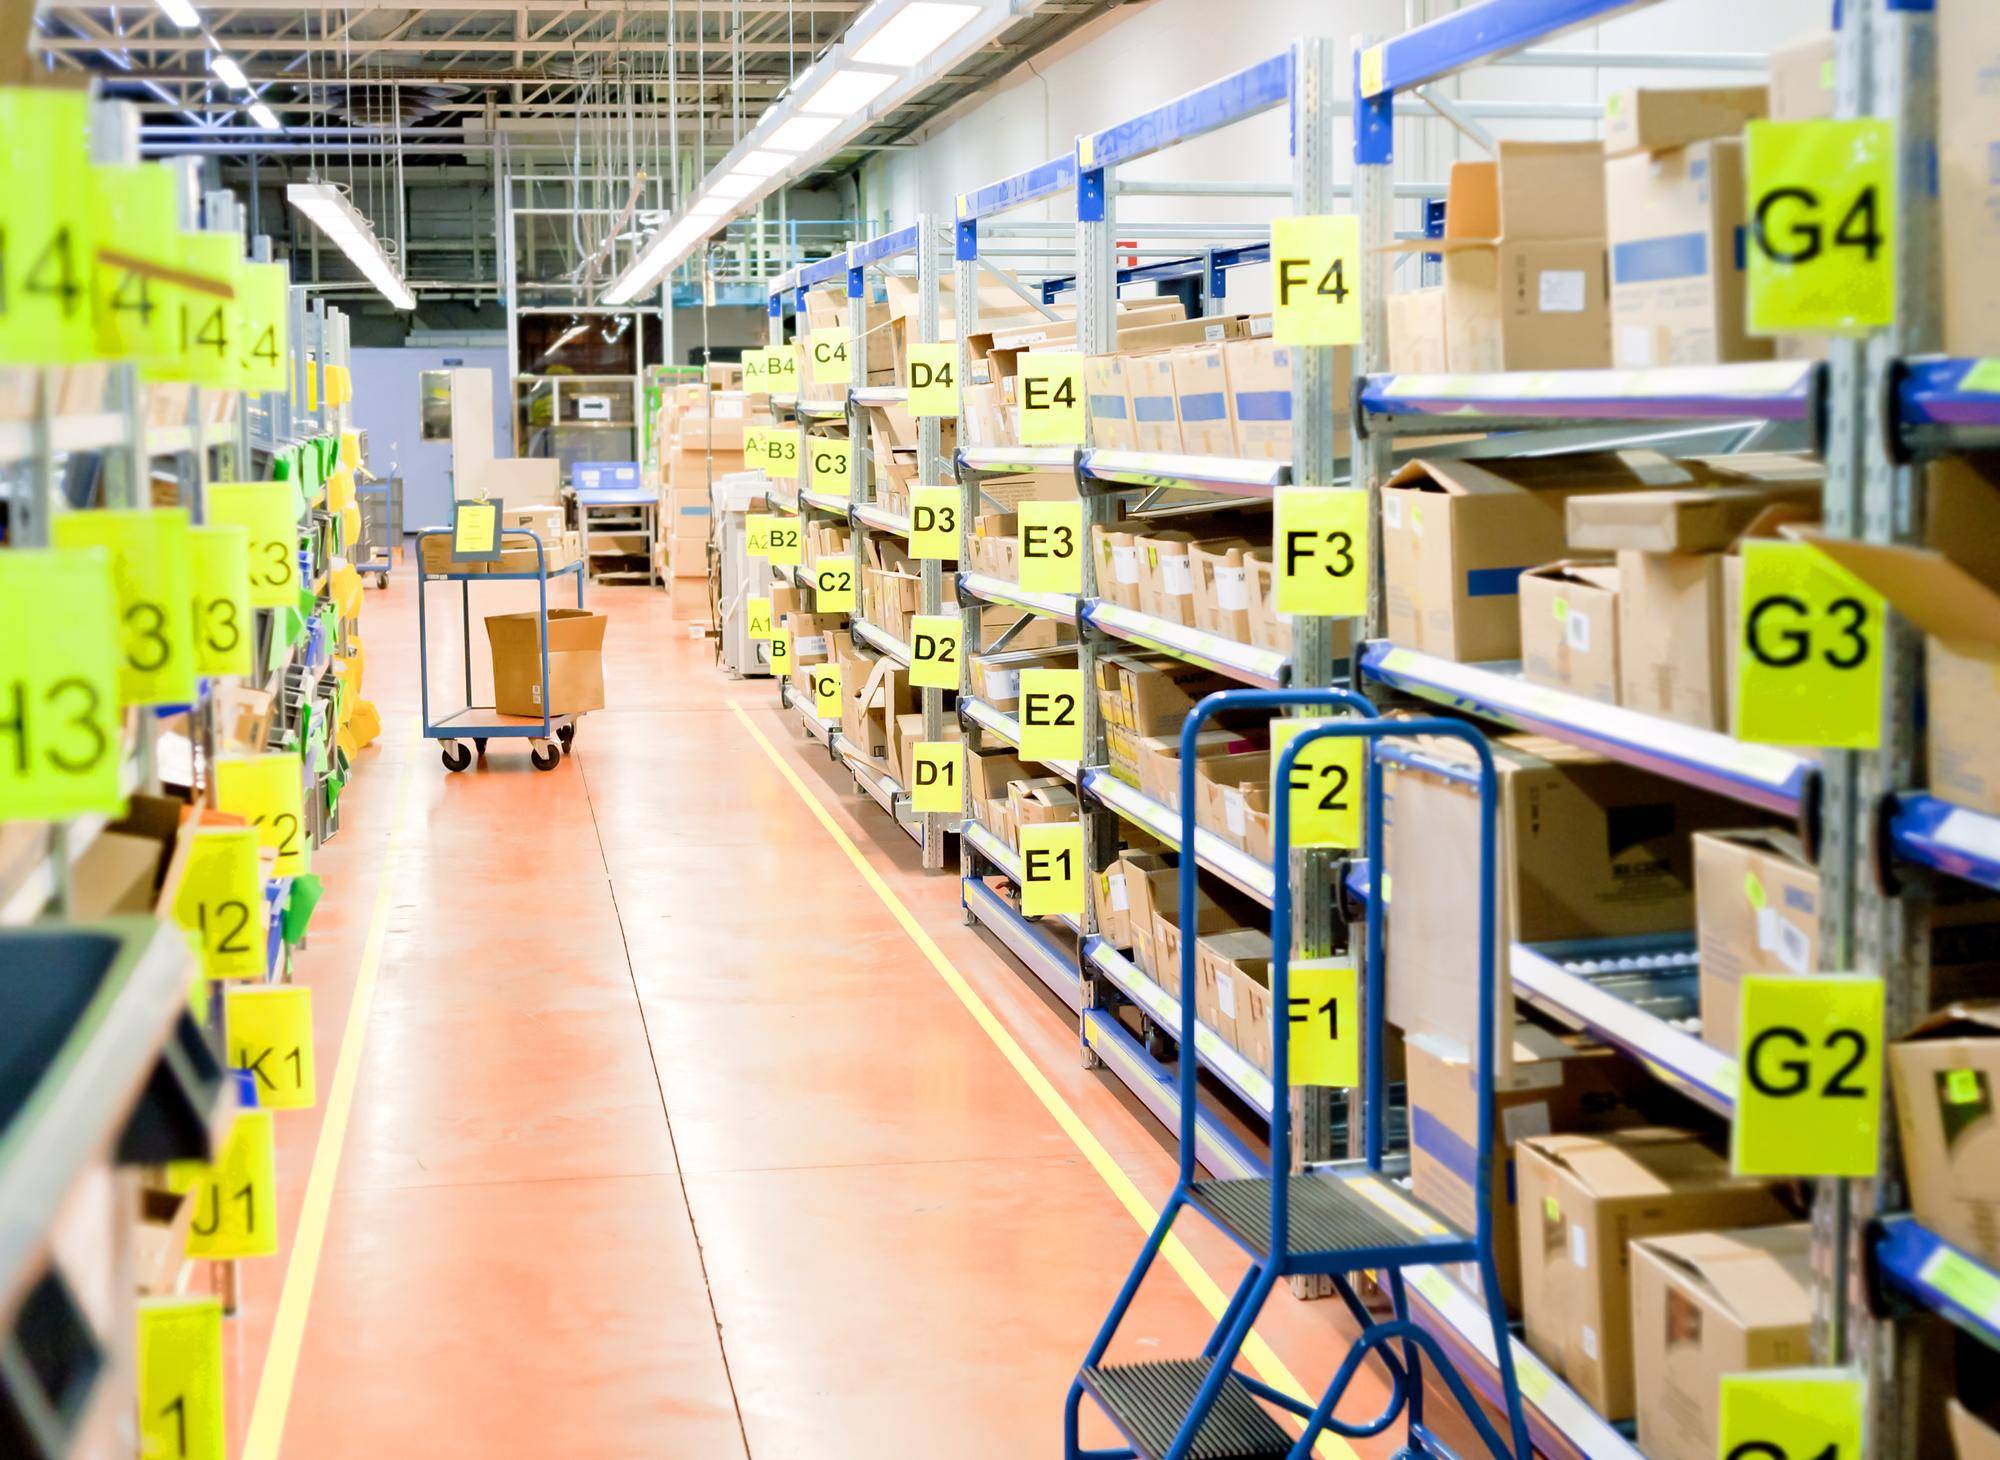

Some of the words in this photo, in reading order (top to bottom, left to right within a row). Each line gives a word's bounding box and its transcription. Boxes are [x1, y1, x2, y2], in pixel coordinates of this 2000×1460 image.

[1752, 184, 1885, 265] G4
[1281, 260, 1348, 305] F4
[242, 325, 279, 368] 4
[815, 343, 847, 362] C4
[768, 358, 794, 374] B4
[912, 363, 953, 388] D4
[1025, 377, 1075, 409] E4
[769, 442, 795, 459] B3
[816, 454, 846, 474] C3
[914, 507, 954, 532] D3
[771, 531, 797, 547] B2
[1024, 526, 1073, 558] E3
[1288, 532, 1353, 577] F3
[250, 542, 291, 586] 3
[818, 572, 851, 592] C2
[915, 635, 955, 662] D2
[1746, 595, 1869, 670] G3
[817, 677, 841, 698] C
[1026, 694, 1074, 725] E2
[917, 761, 953, 786] D1
[253, 813, 299, 859] 2
[1026, 849, 1070, 881] E1
[239, 1046, 303, 1092] K1
[1745, 1027, 1870, 1098] G2
[191, 1183, 253, 1236] J1
